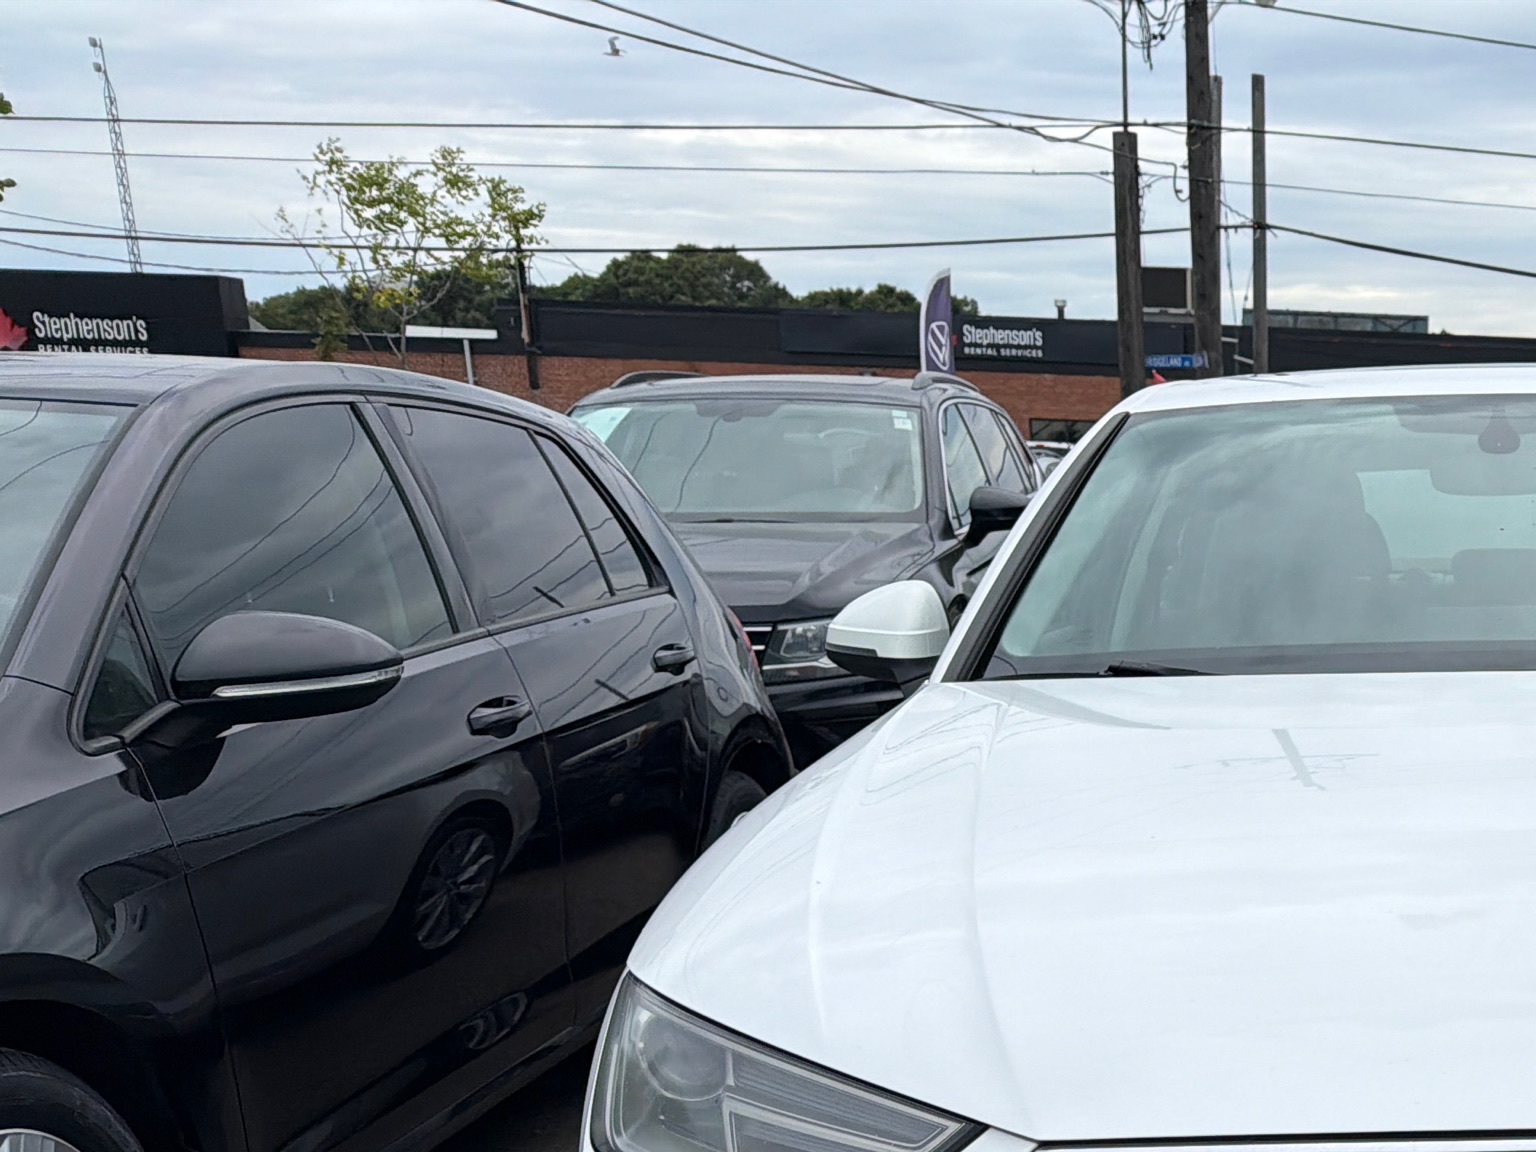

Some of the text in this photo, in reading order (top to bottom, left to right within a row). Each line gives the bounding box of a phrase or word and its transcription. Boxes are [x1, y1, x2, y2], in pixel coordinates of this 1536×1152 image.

[32, 311, 148, 341] Stephenson's
[962, 324, 1043, 346] Stephenson's
[963, 346, 1043, 358] RENTAL SERVICES
